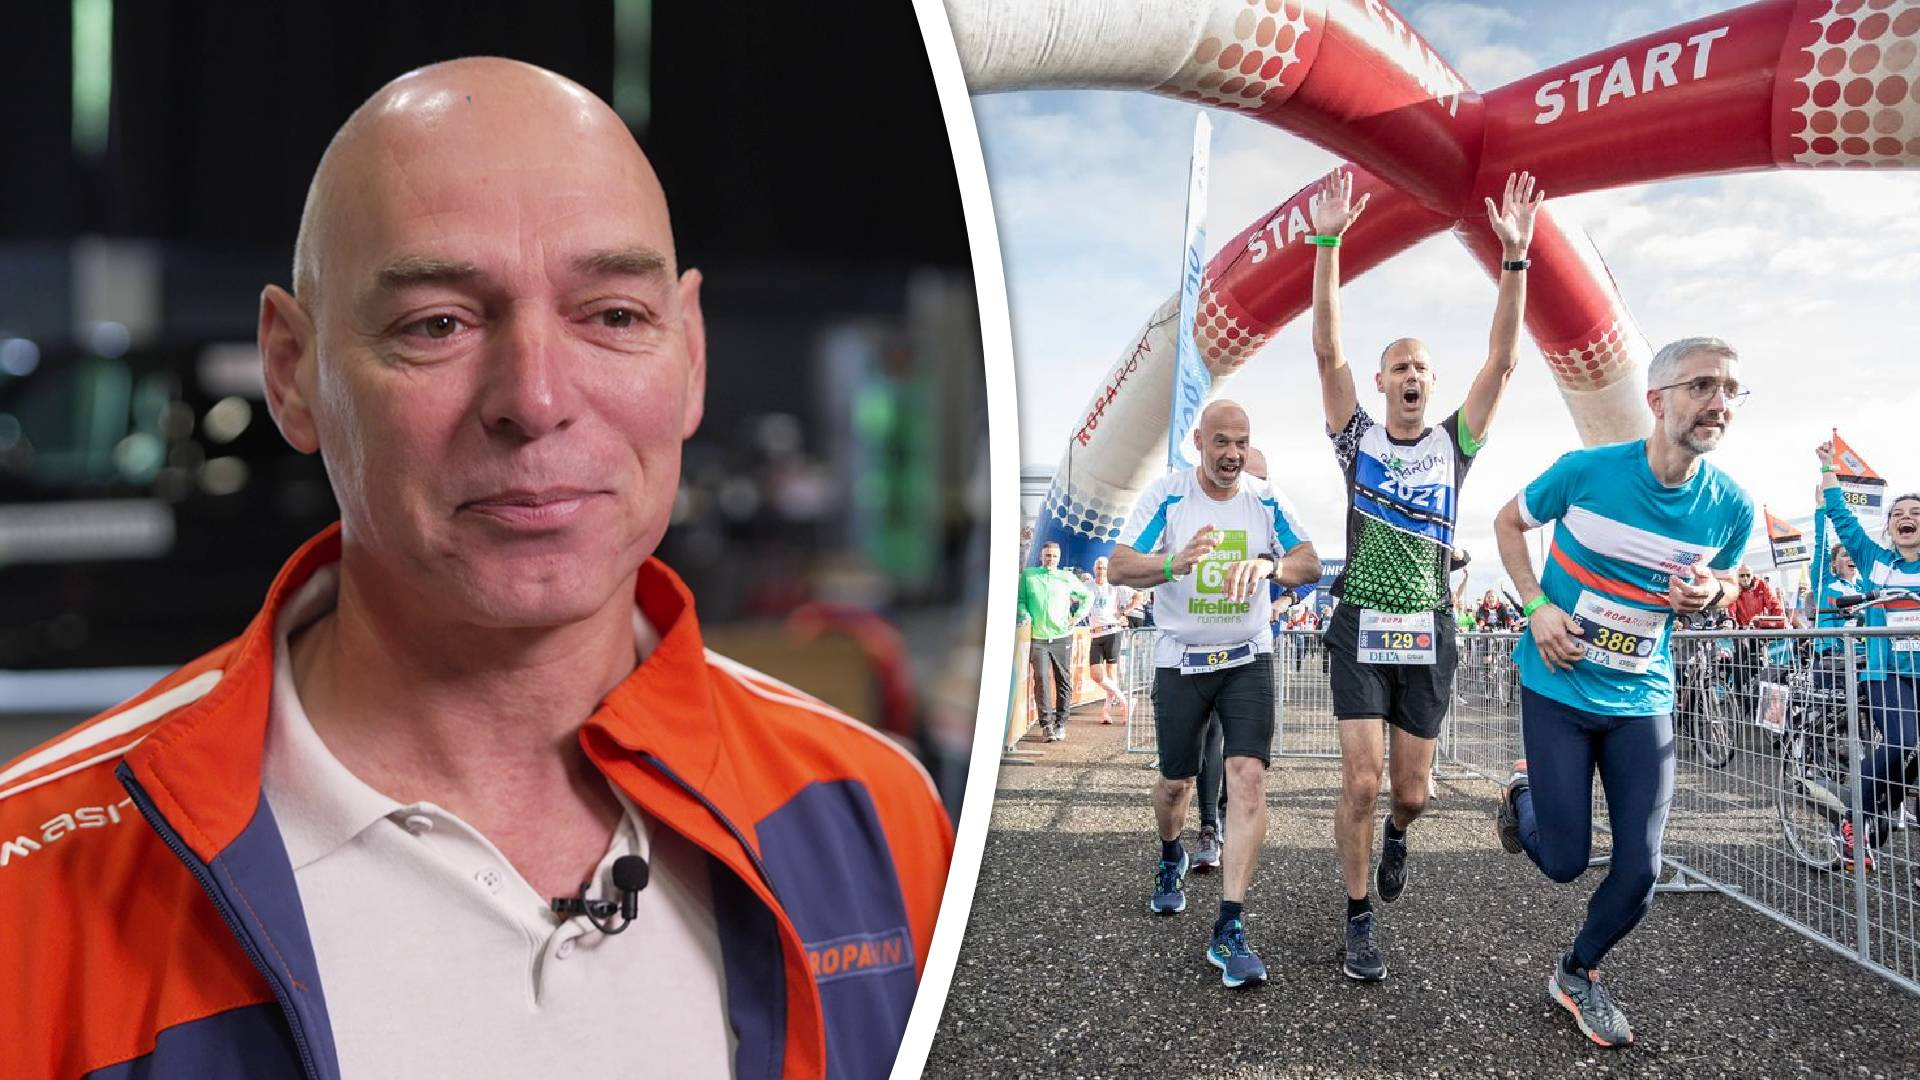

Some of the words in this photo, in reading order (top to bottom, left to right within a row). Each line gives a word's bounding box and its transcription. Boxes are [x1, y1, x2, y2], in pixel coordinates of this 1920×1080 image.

[1534, 26, 1730, 125] START
[1378, 479, 1444, 510] 2021
[1188, 597, 1250, 615] lifeline
[1198, 615, 1242, 625] runners
[1381, 631, 1414, 649] 129
[1593, 628, 1637, 654] 386
[1207, 651, 1229, 665] 62
